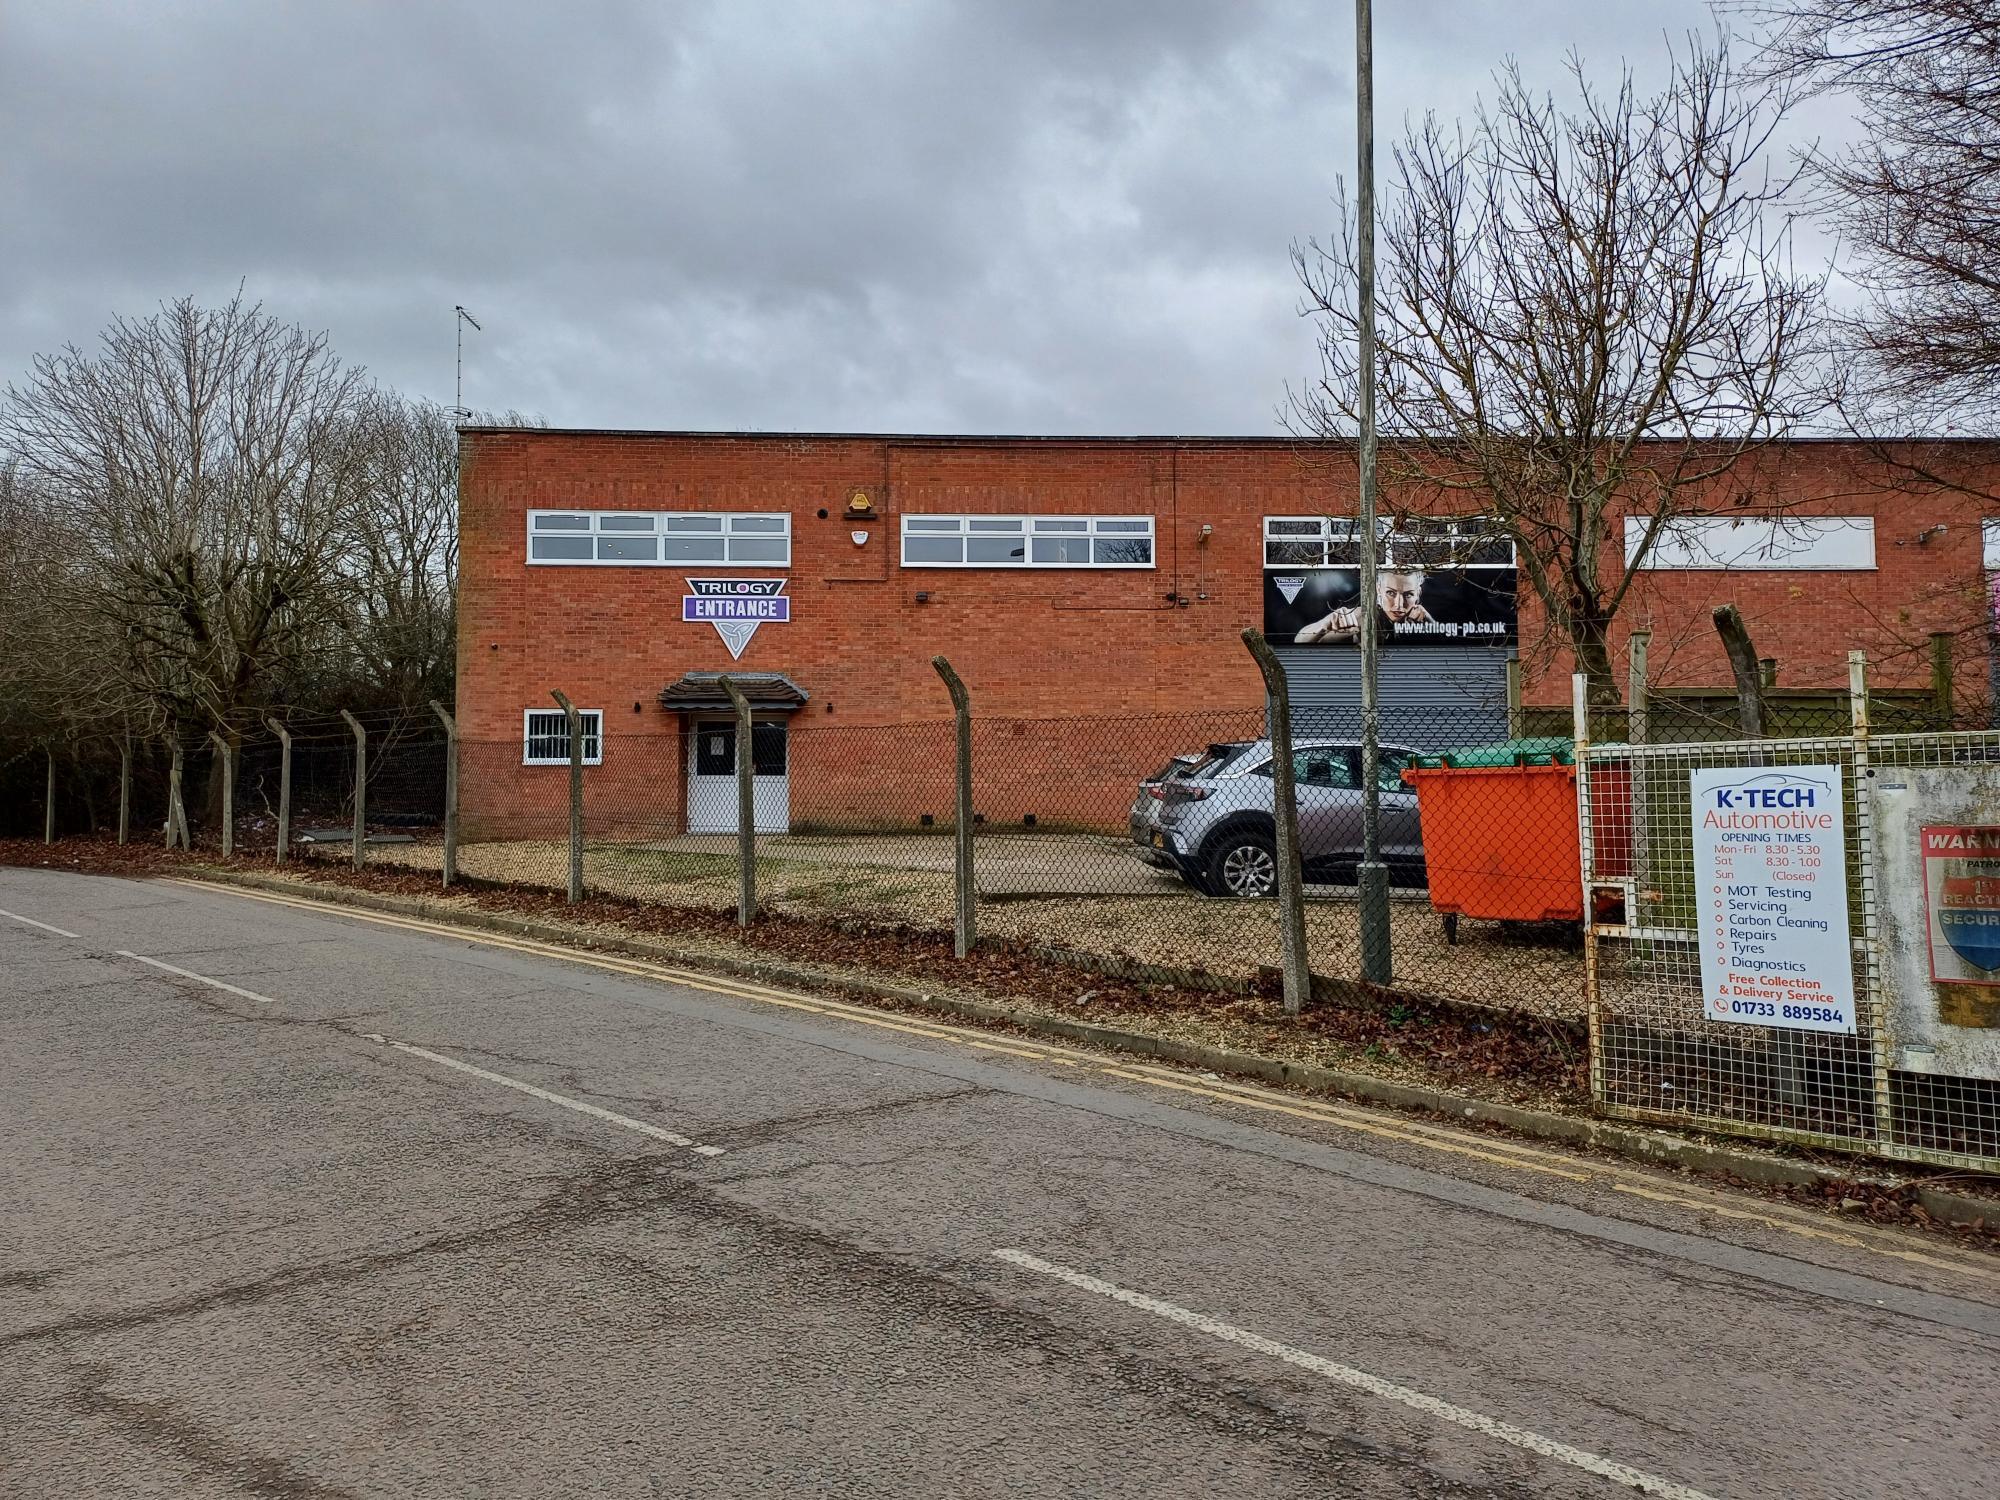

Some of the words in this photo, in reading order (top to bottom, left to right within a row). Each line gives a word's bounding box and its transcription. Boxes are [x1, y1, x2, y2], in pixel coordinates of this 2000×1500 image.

[698, 583, 774, 593] TRILOGY
[695, 600, 777, 616] ENTRANCE
[1394, 621, 1506, 637] www.trilogy-pb.co.uk
[1717, 789, 1815, 808] K-TECH
[1703, 809, 1833, 829] Automotive
[1721, 833, 1771, 843] OPENING
[1776, 833, 1812, 843] TIMES
[1715, 856, 1733, 865] Sat
[1766, 857, 1789, 867] 8.30
[1715, 870, 1734, 879] Sun
[1772, 871, 1816, 881] (Closed)
[1728, 885, 1758, 896] MOT
[1765, 886, 1812, 901] Testing
[1728, 899, 1787, 914] Servicing
[1729, 914, 1771, 926] Carbon
[1777, 916, 1828, 932] Cleaning
[1730, 928, 1777, 941] Repairs
[1731, 941, 1765, 955] Tyres
[1732, 956, 1806, 972] Diagnostics
[1729, 973, 1755, 985] Free
[1760, 975, 1821, 989] Collection
[1719, 984, 1729, 994] &
[1734, 986, 1783, 1001] Delivery
[1787, 990, 1834, 1003] Service
[1732, 1000, 1775, 1016] 01733
[1782, 1004, 1843, 1023] 889584
